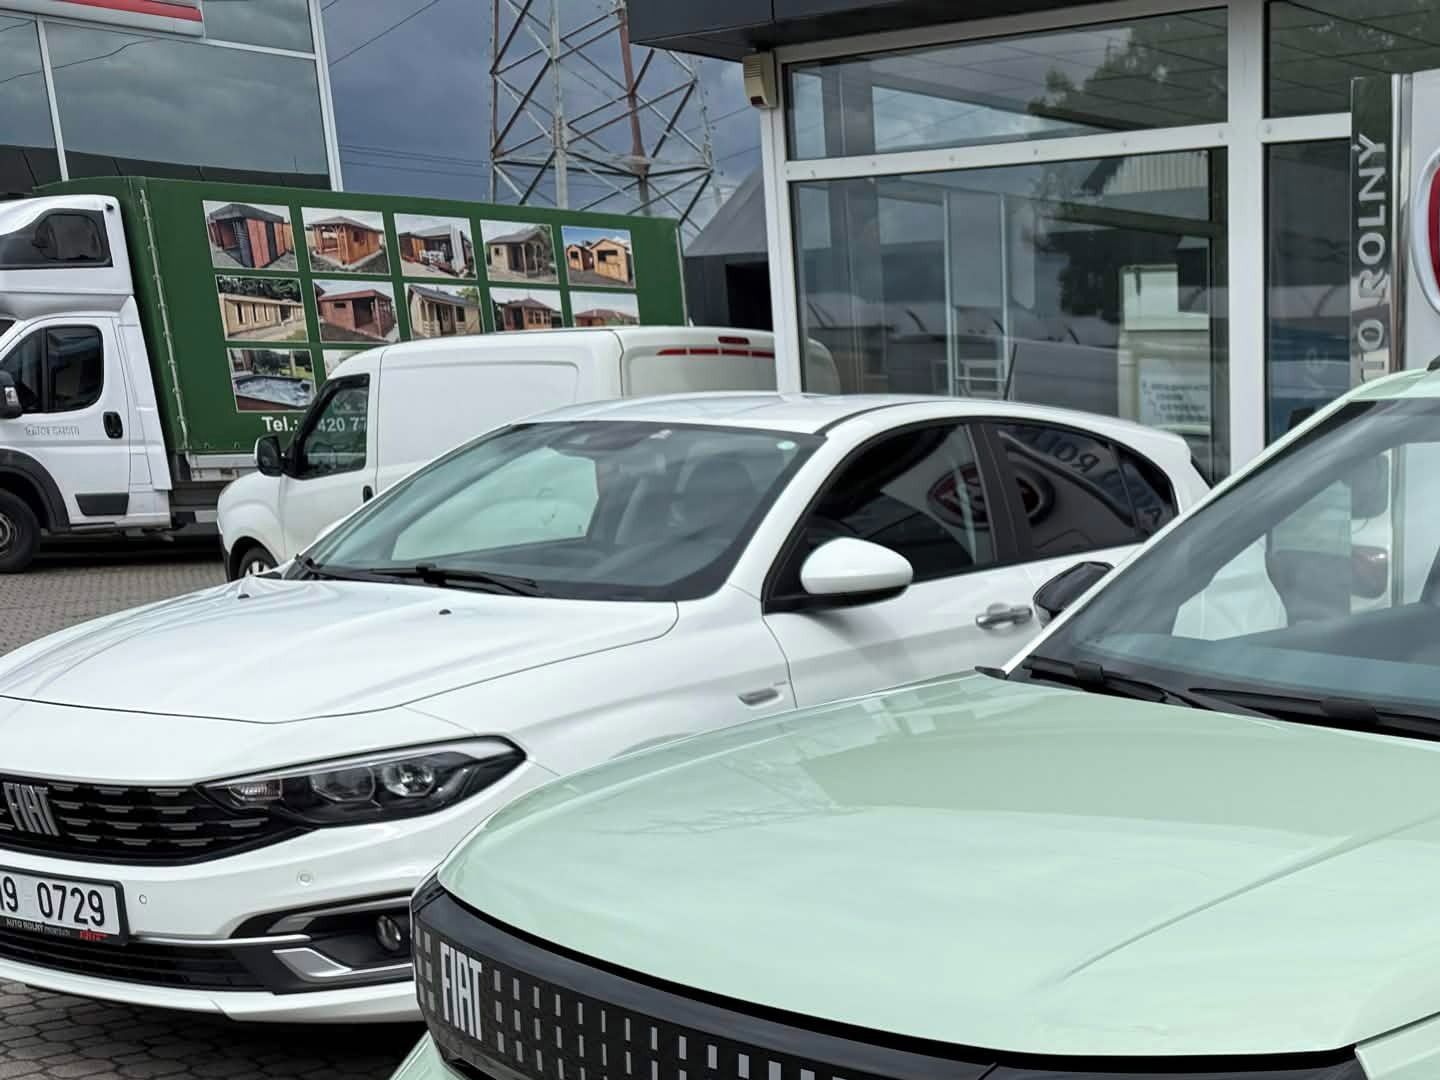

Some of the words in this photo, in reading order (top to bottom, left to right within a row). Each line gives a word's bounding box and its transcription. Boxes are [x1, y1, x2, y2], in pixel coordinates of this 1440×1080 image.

[1352, 133, 1387, 302] ROLNÝ
[1357, 318, 1386, 386] TO
[3, 782, 60, 836] FIAT
[37, 882, 106, 926] 0729
[440, 941, 482, 1041] FIAT
